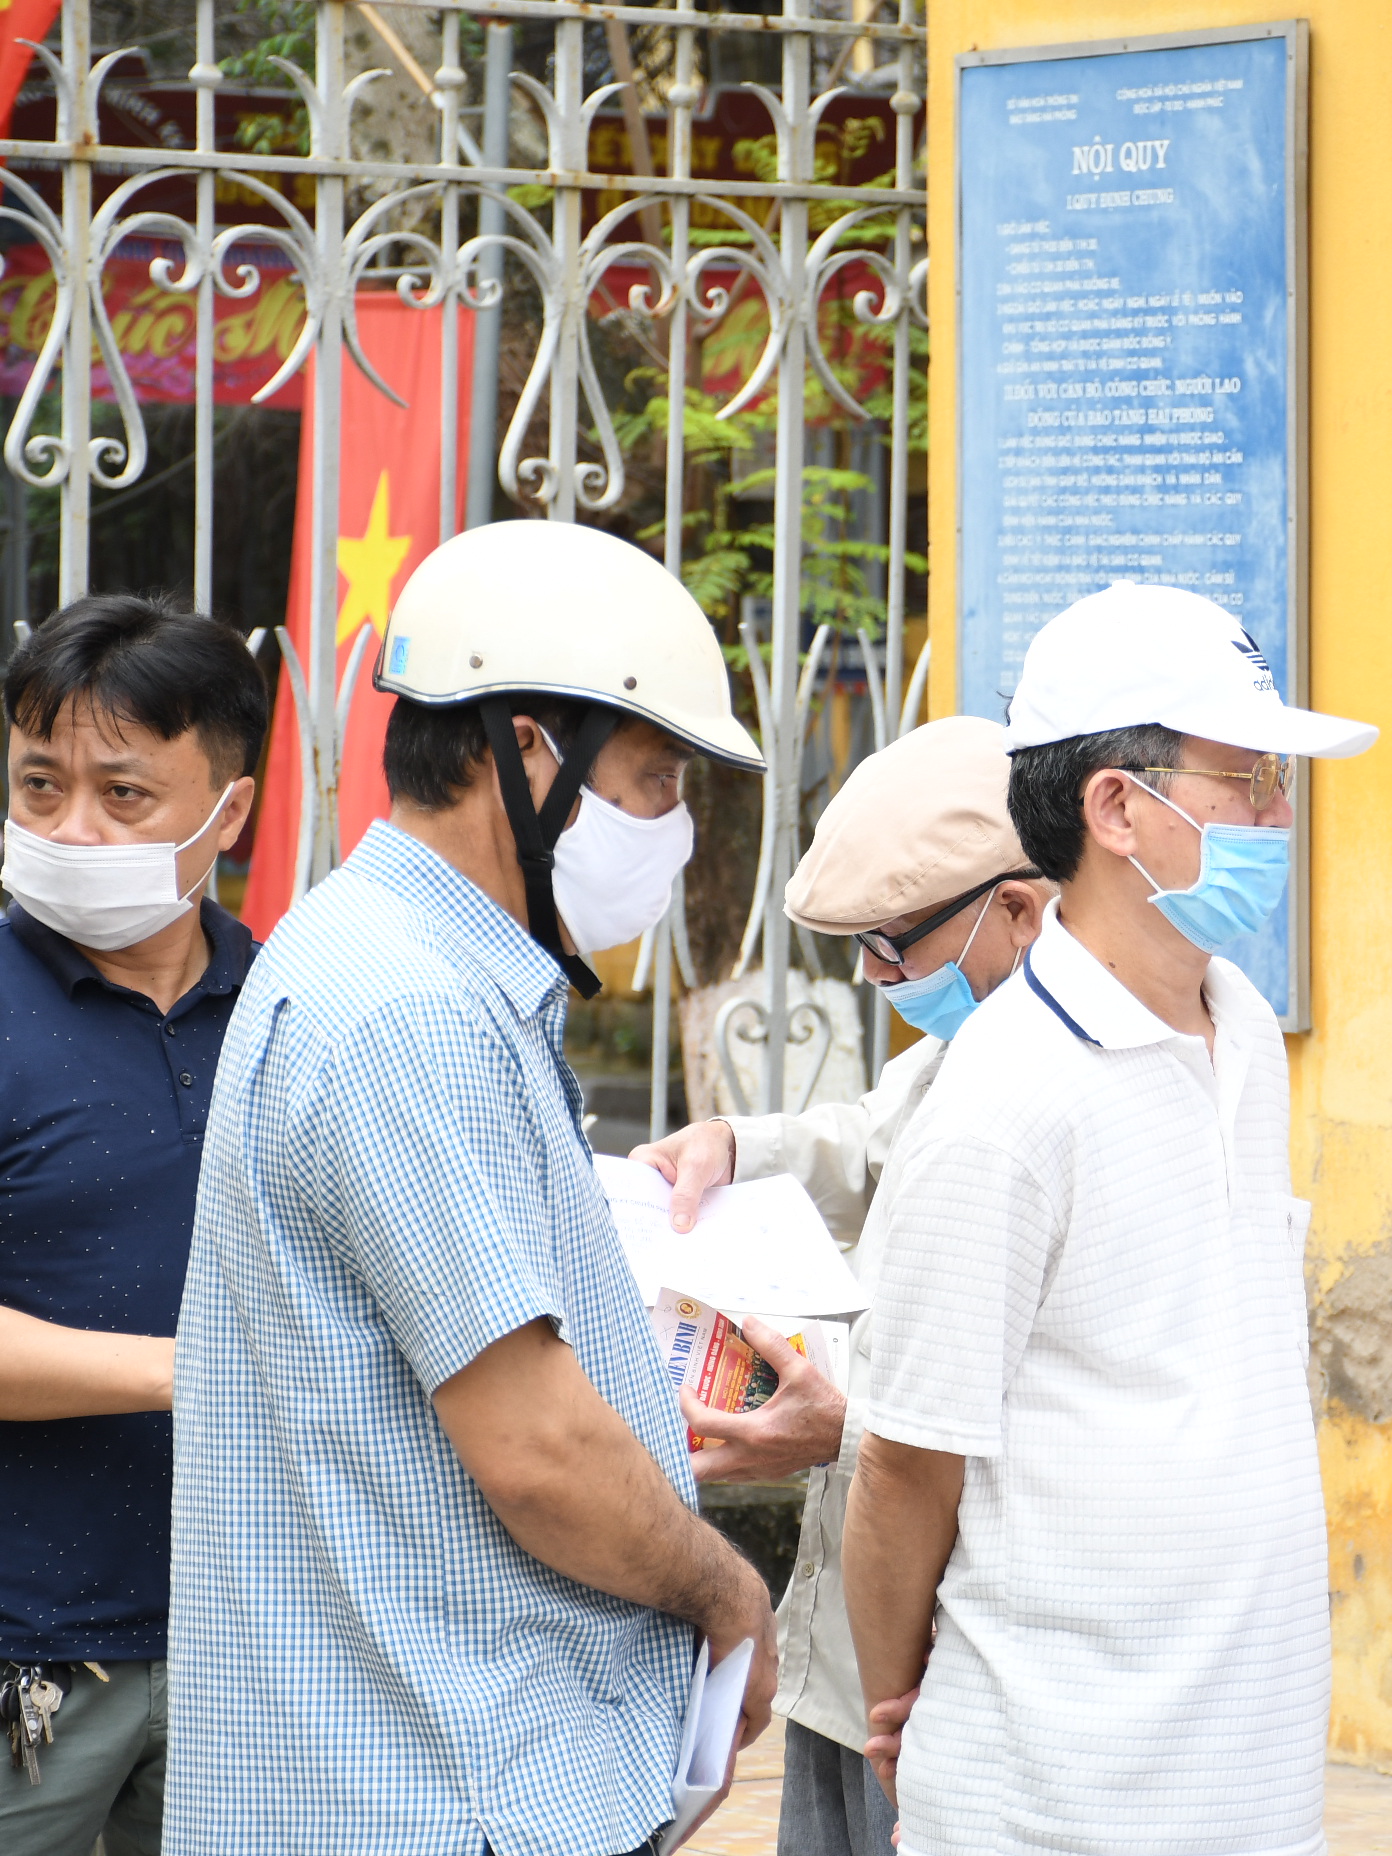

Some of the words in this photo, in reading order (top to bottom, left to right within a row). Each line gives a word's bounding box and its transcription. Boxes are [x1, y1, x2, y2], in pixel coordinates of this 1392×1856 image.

[1072, 135, 1114, 181] NỘI
[1120, 140, 1170, 172] QUY
[1214, 377, 1241, 393] LAO
[672, 1322, 697, 1354] BINH
